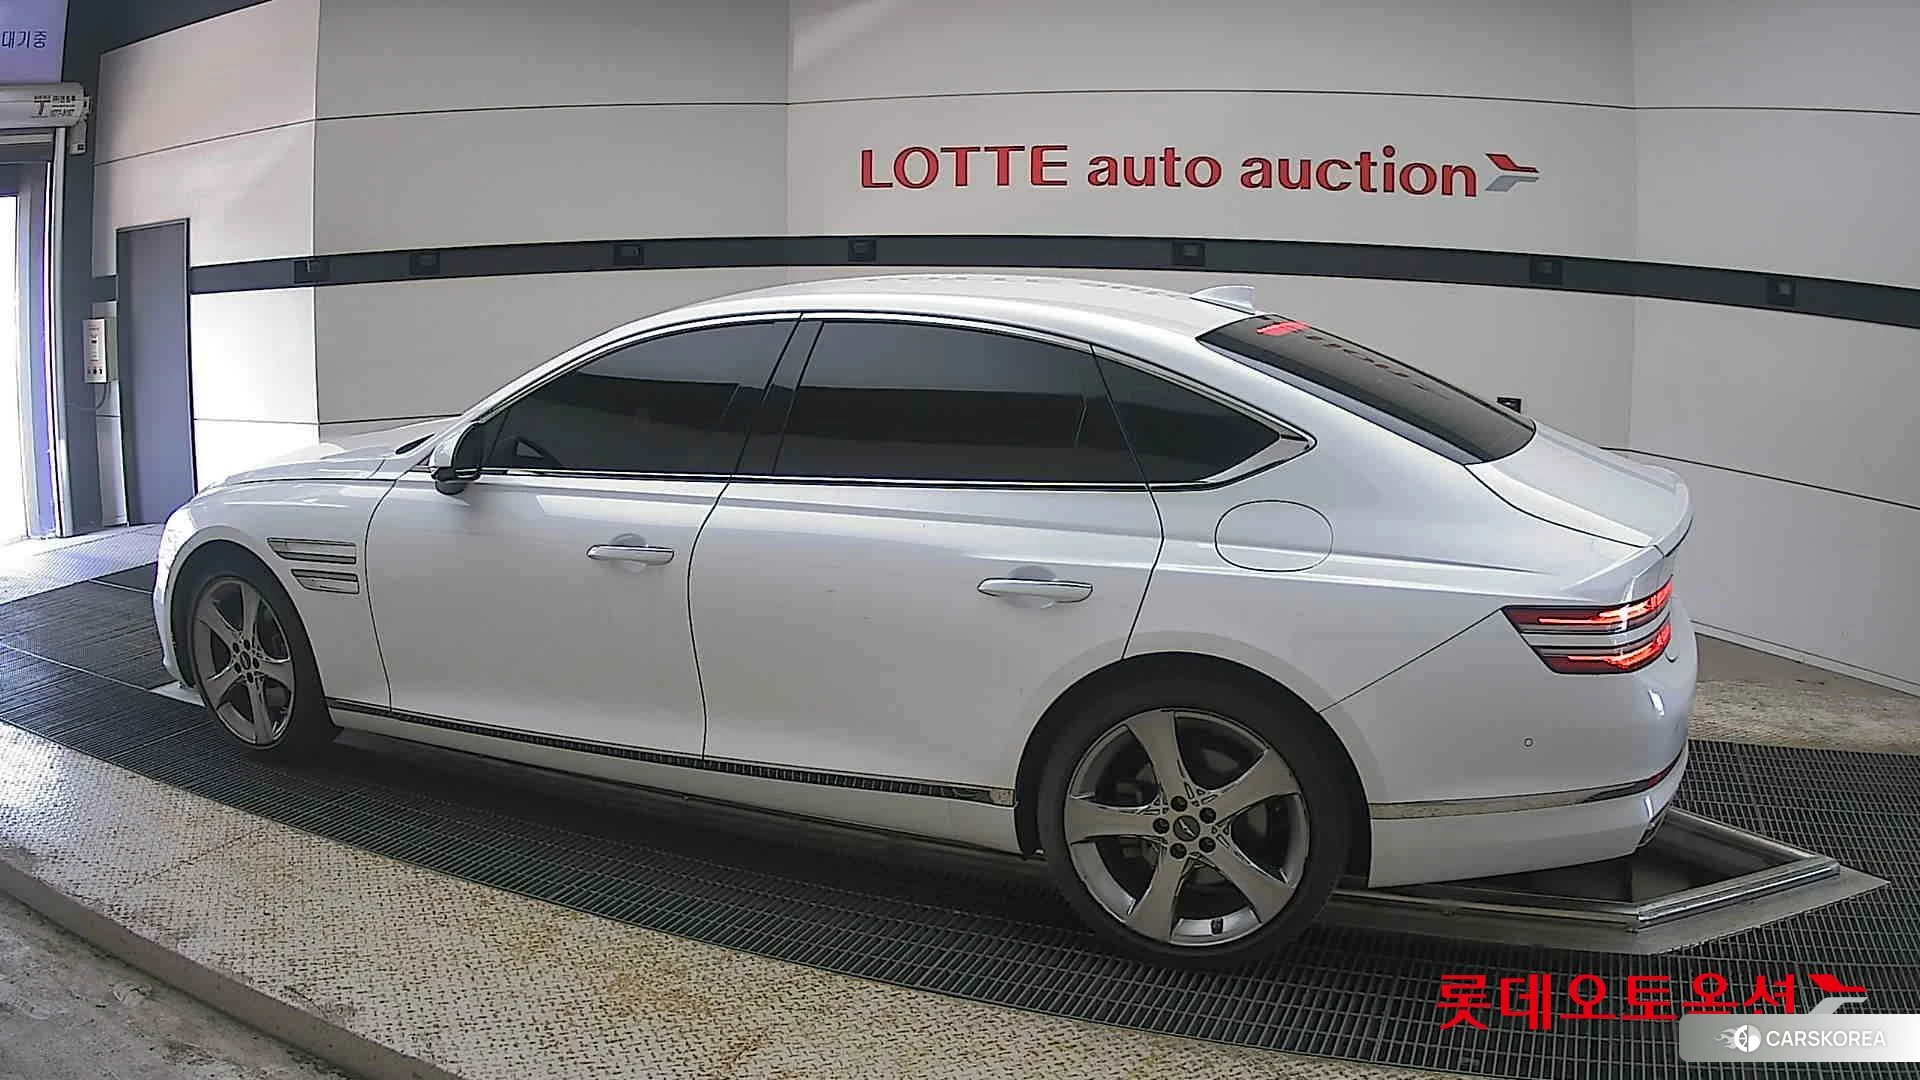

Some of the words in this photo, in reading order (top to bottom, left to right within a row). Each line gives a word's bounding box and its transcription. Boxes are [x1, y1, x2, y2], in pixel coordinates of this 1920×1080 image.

[861, 145, 1068, 189] LOTTE
[1087, 147, 1222, 188] auto
[1240, 145, 1477, 197] auction
